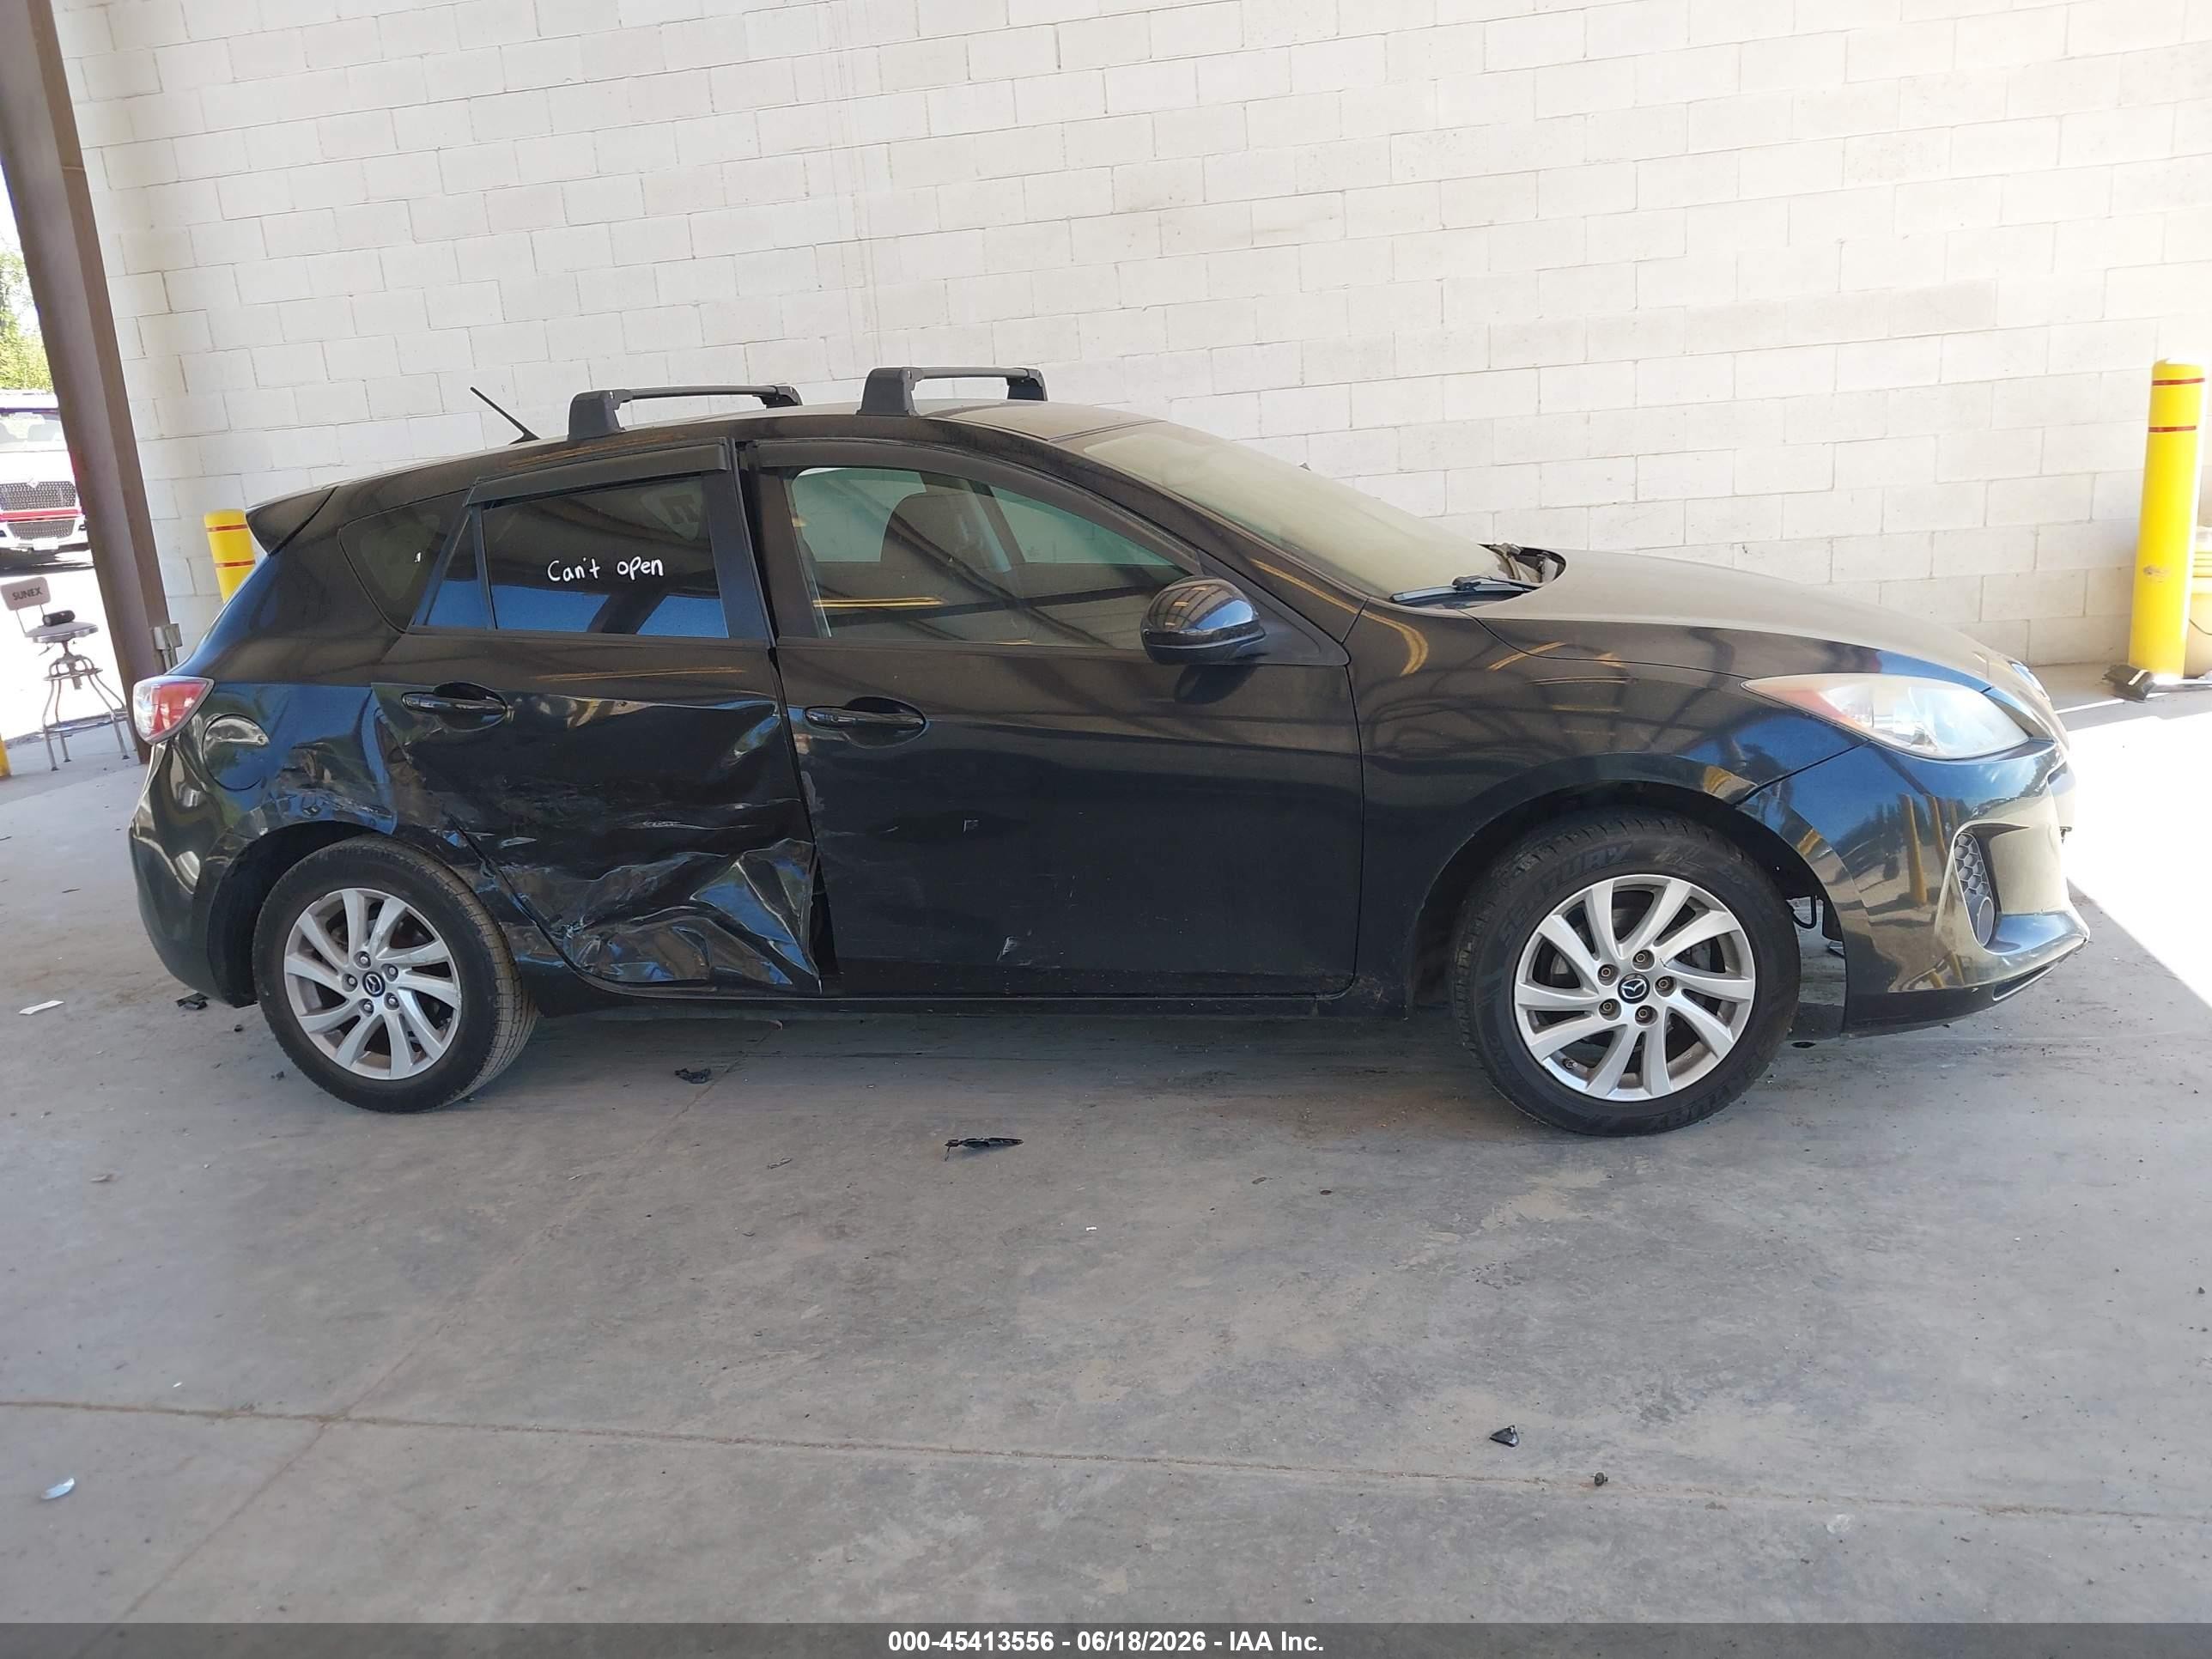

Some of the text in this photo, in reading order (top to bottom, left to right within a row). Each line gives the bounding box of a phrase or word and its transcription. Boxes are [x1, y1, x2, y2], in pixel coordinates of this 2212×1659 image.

[547, 556, 664, 582] Can't open
[12, 586, 42, 601] SUNEX
